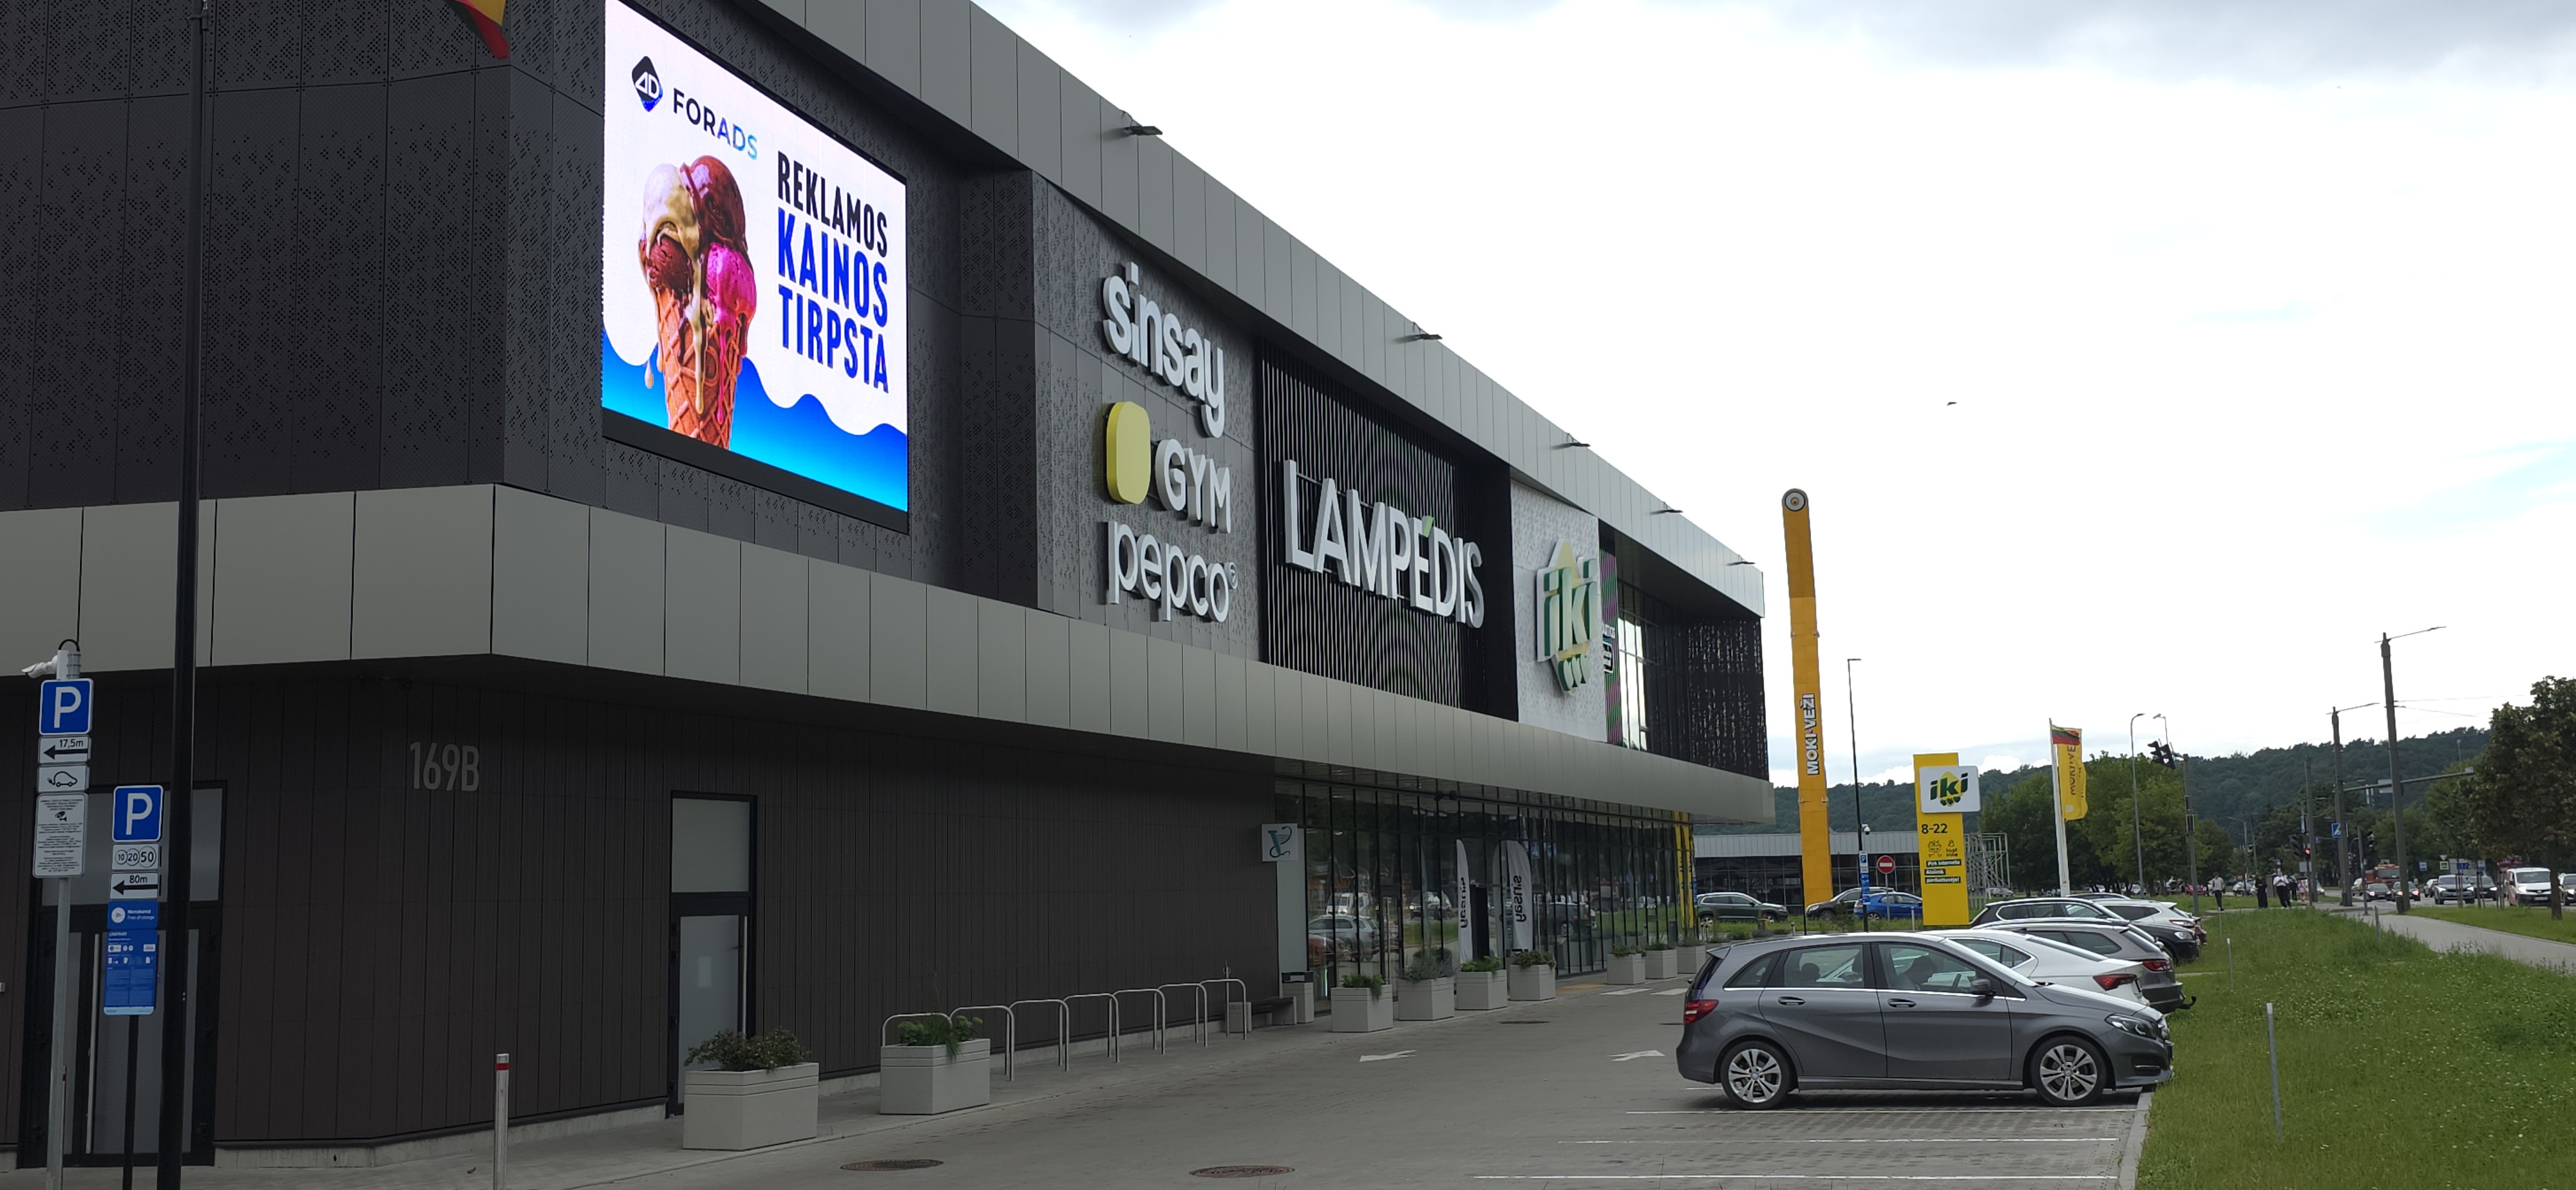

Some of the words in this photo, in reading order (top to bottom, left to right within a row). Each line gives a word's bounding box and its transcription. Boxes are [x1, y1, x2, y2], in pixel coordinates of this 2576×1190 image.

[674, 88, 757, 160] FORADS
[778, 150, 887, 258] REKLAMOS
[778, 207, 887, 328] KAINOS
[779, 284, 889, 393] TIRPSTA
[1103, 261, 1224, 439] sinsay
[1155, 439, 1231, 534] GYM
[1544, 558, 1598, 657] iki
[54, 686, 81, 728] P
[59, 739, 83, 749] 17,5m
[410, 742, 479, 791] 169B
[1930, 773, 1968, 801] iki
[126, 793, 153, 835] P
[1921, 823, 1948, 834] 8-22
[128, 853, 138, 862] 20
[141, 851, 154, 862] 50
[129, 874, 147, 884] 80m
